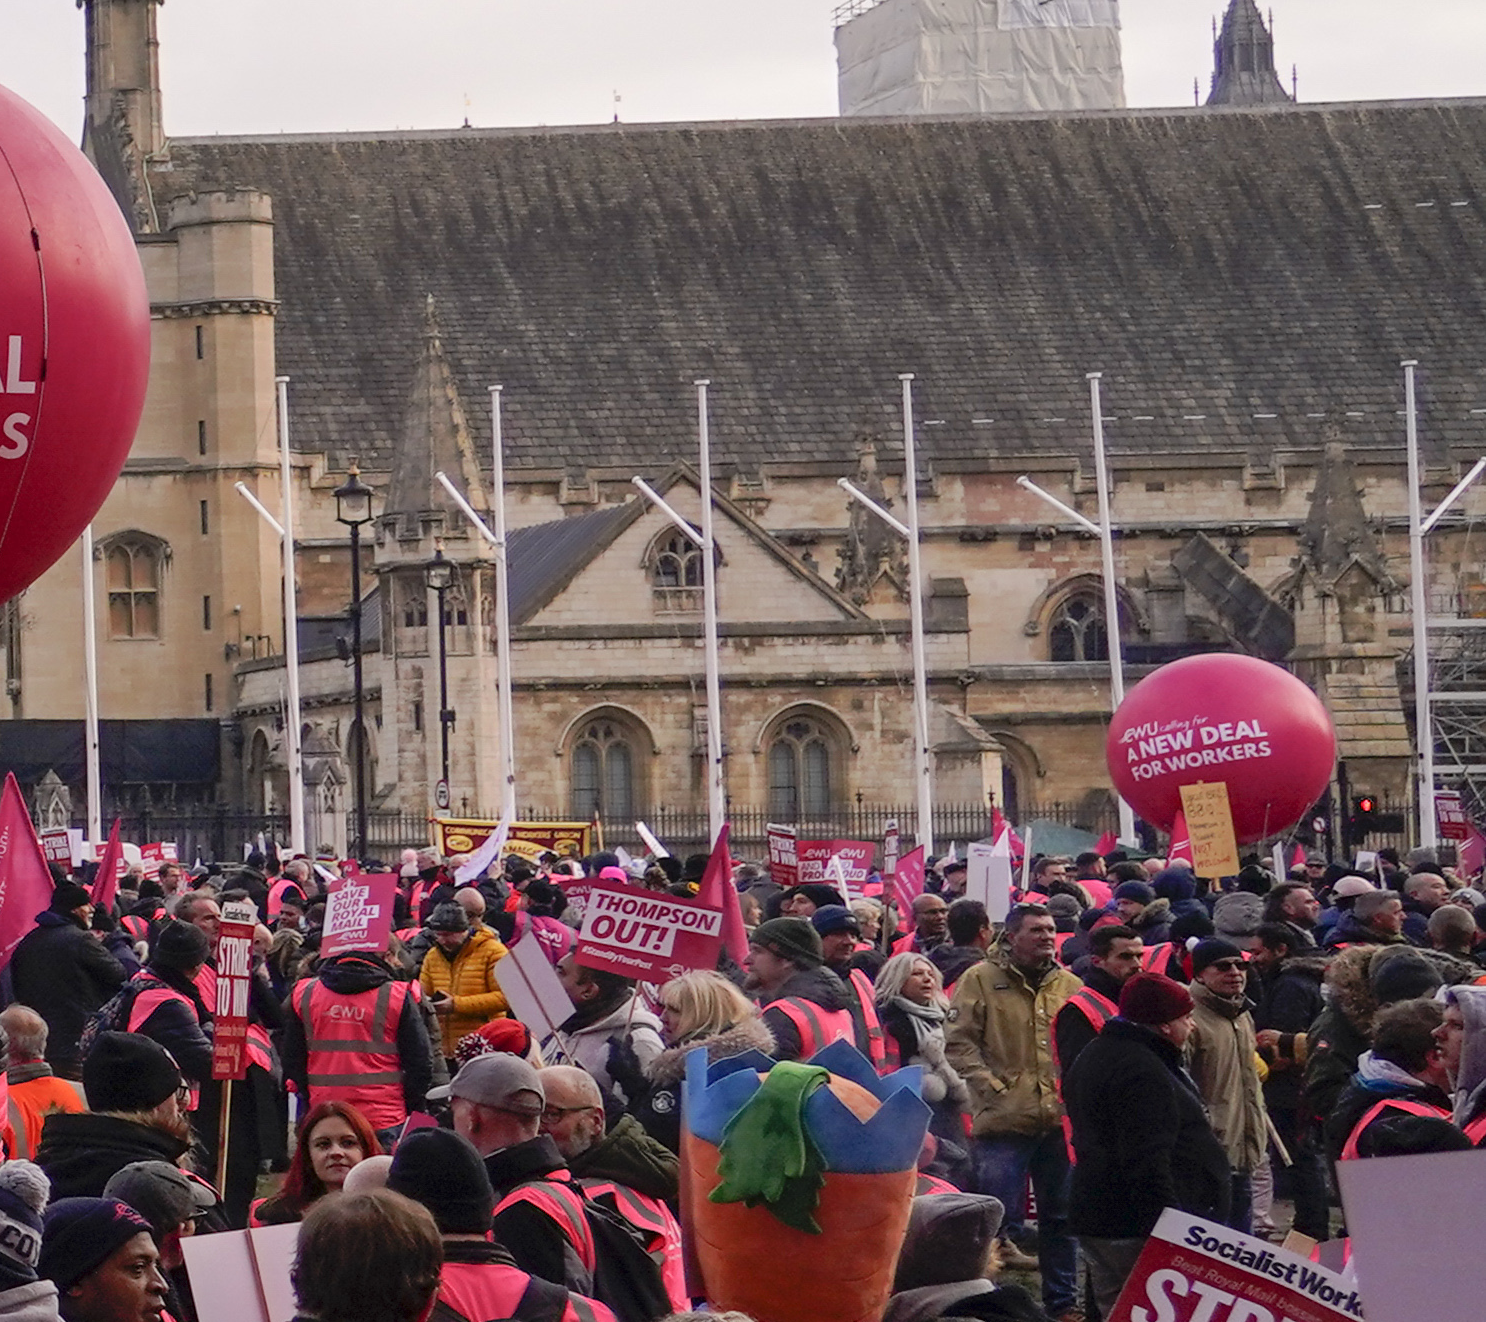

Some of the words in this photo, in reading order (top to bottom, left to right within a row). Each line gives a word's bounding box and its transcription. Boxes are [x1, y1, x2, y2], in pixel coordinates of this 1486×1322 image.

[1118, 721, 1158, 744] CWU
[1159, 720, 1190, 732] calling
[1128, 747, 1138, 764] A
[1139, 729, 1193, 759] NEW
[1200, 719, 1268, 745] DEAL
[1131, 761, 1167, 781] FOR
[1165, 741, 1272, 772] WORKERS
[43, 836, 68, 849] STRIKE
[333, 888, 366, 903] SAVE
[333, 899, 361, 912] OUR
[332, 907, 375, 922] ROYAL
[596, 894, 716, 930] THOMPSON
[331, 917, 364, 932] MAIL
[591, 915, 669, 951] OUT!
[217, 977, 230, 1017] TO
[323, 1004, 365, 1020] CWU
[1207, 1267, 1245, 1293] Royal
[1247, 1282, 1276, 1303] Mail
